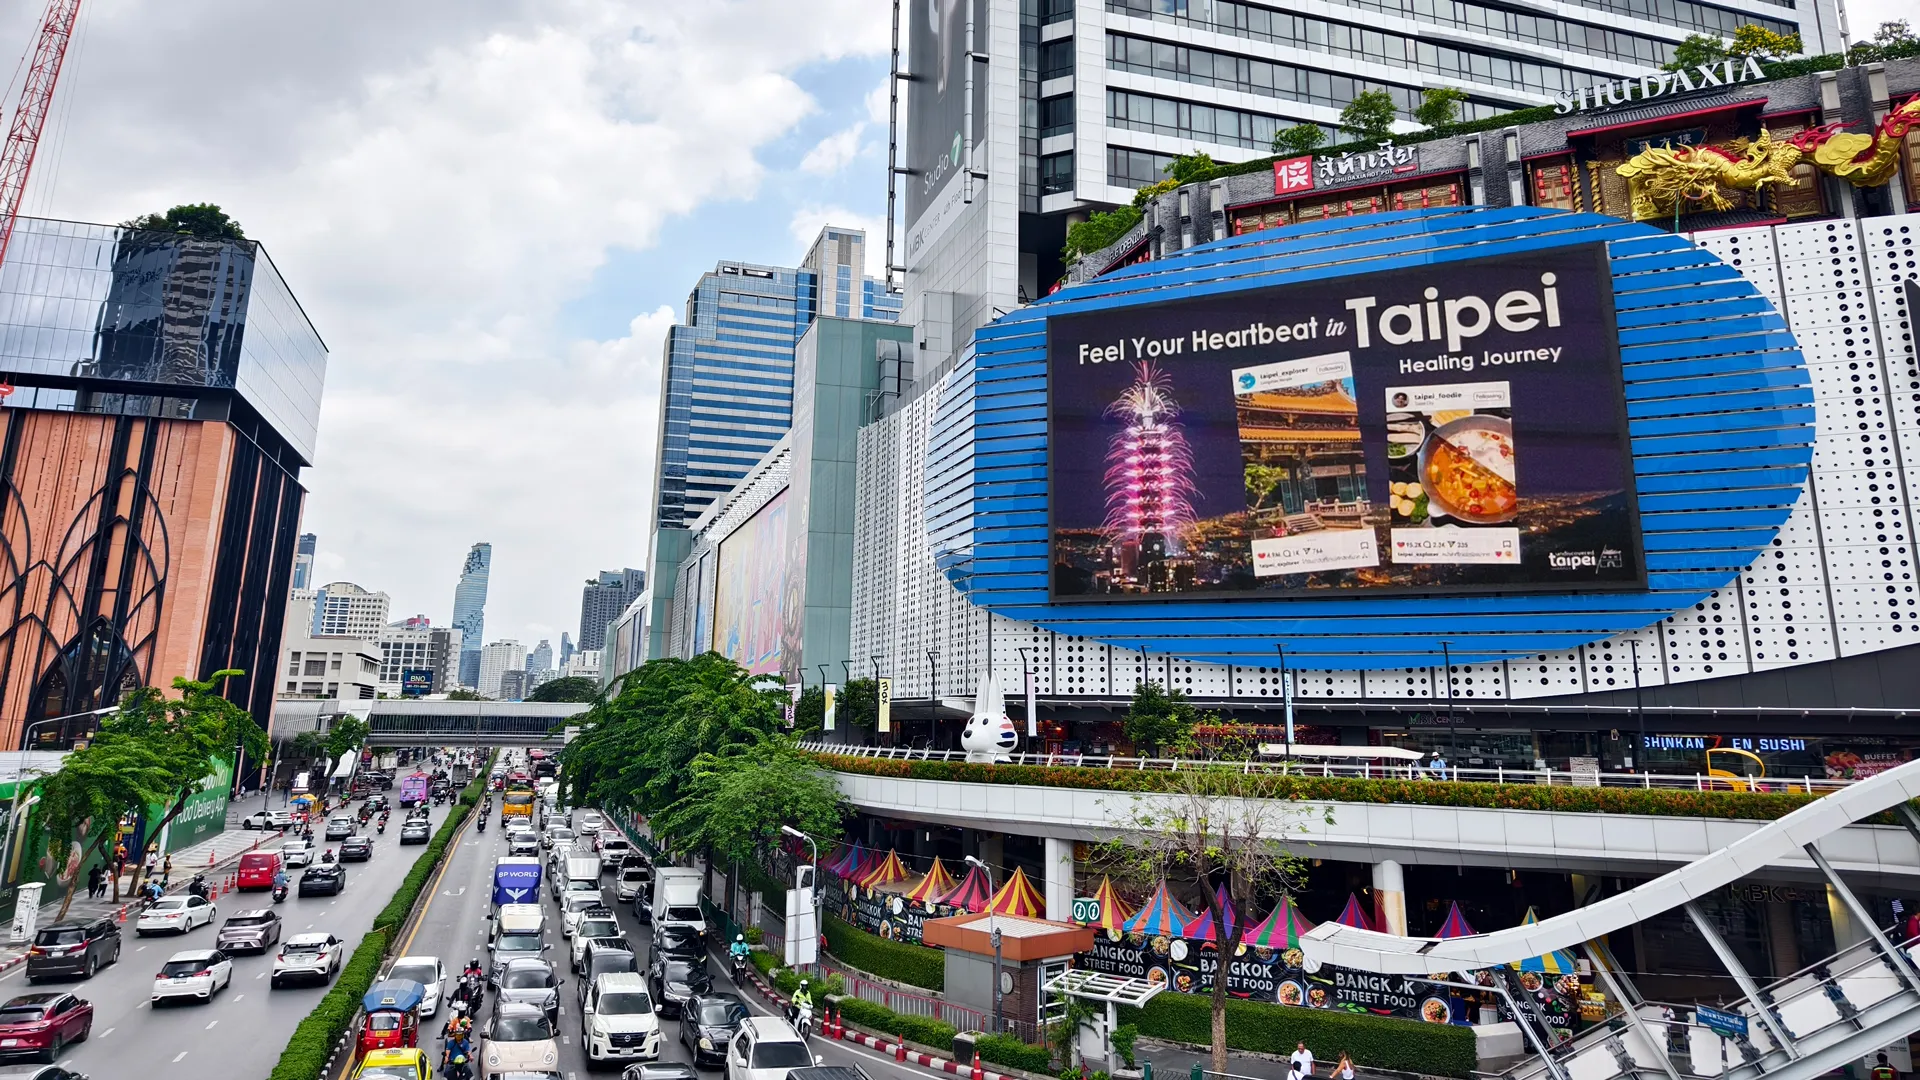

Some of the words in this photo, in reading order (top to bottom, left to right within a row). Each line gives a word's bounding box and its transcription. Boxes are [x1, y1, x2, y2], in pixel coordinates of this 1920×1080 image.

[923, 152, 949, 195] Studio
[1366, 170, 1380, 179] HOT
[1380, 168, 1393, 176] POT
[1079, 339, 1125, 365] Feel
[1131, 336, 1185, 359] Your
[1192, 316, 1318, 352] Heartbeat
[1324, 318, 1348, 338] in
[1345, 271, 1562, 353] Taipei
[1399, 354, 1475, 375] Healing
[1480, 346, 1563, 367] Journey
[1414, 392, 1462, 401] taipei_foodie
[1548, 552, 1596, 570] taipei
[881, 681, 889, 705] max
[1759, 738, 1806, 751] SUSHI
[1864, 752, 1897, 760] BUFFET
[193, 796, 216, 820] Delivery
[1084, 957, 1117, 972] STREET
[1119, 962, 1145, 976] FOOD
[1200, 958, 1273, 979] BAGKOK
[1201, 974, 1240, 988] STET
[1243, 977, 1274, 992] FOOD
[1336, 988, 1380, 1004] STREET
[1383, 993, 1417, 1008] FOOD
